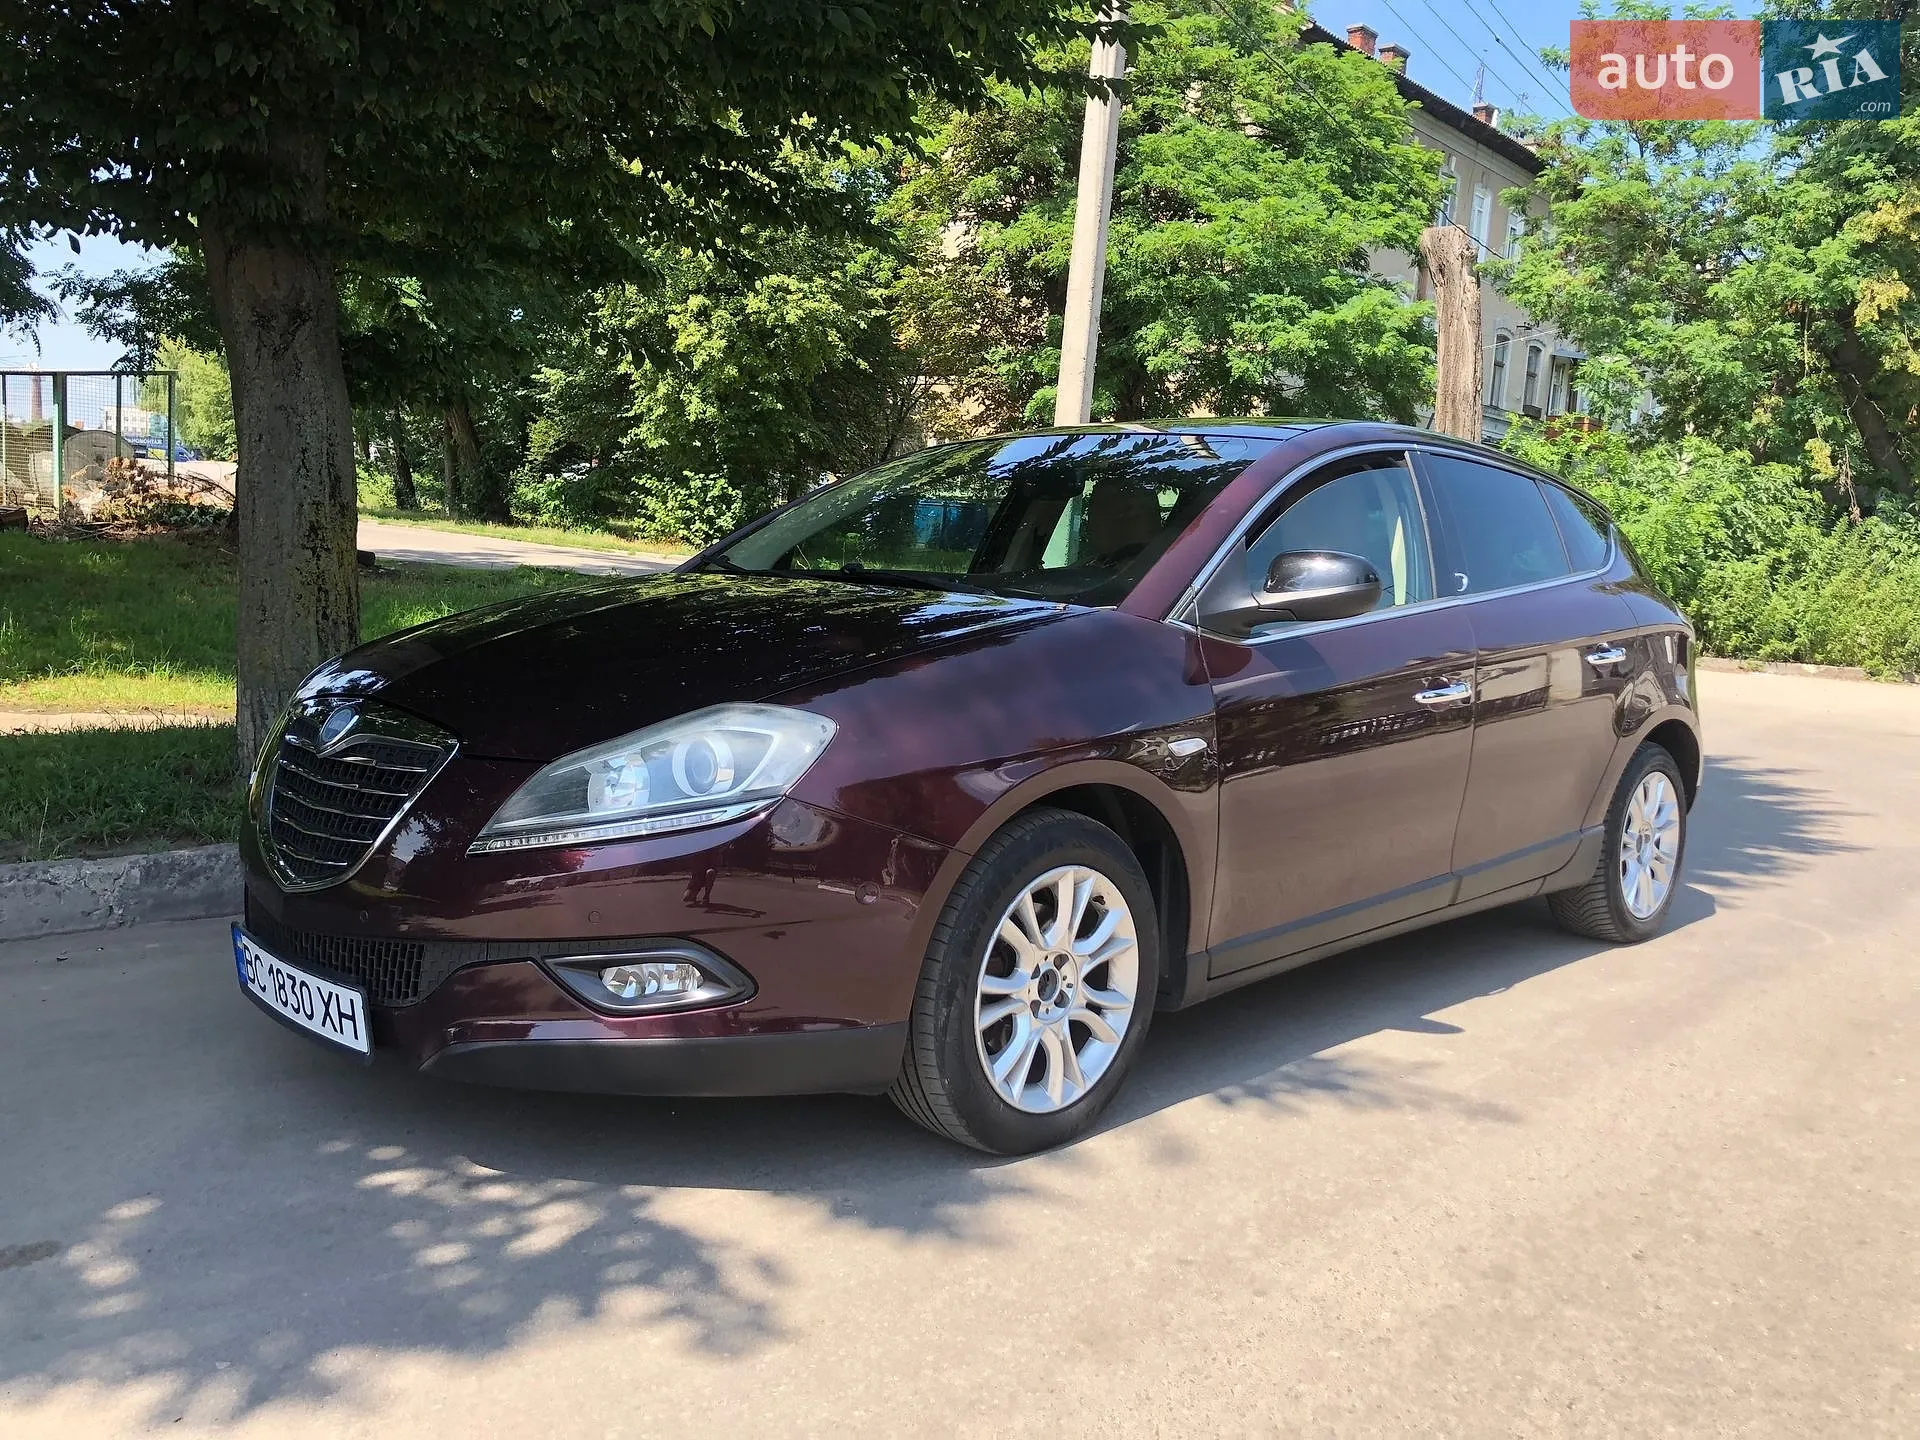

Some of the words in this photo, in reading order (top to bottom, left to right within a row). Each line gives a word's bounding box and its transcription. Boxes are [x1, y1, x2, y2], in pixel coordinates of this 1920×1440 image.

[243, 943, 267, 993] BC
[268, 963, 314, 1021] 1830
[317, 985, 359, 1041] XH
